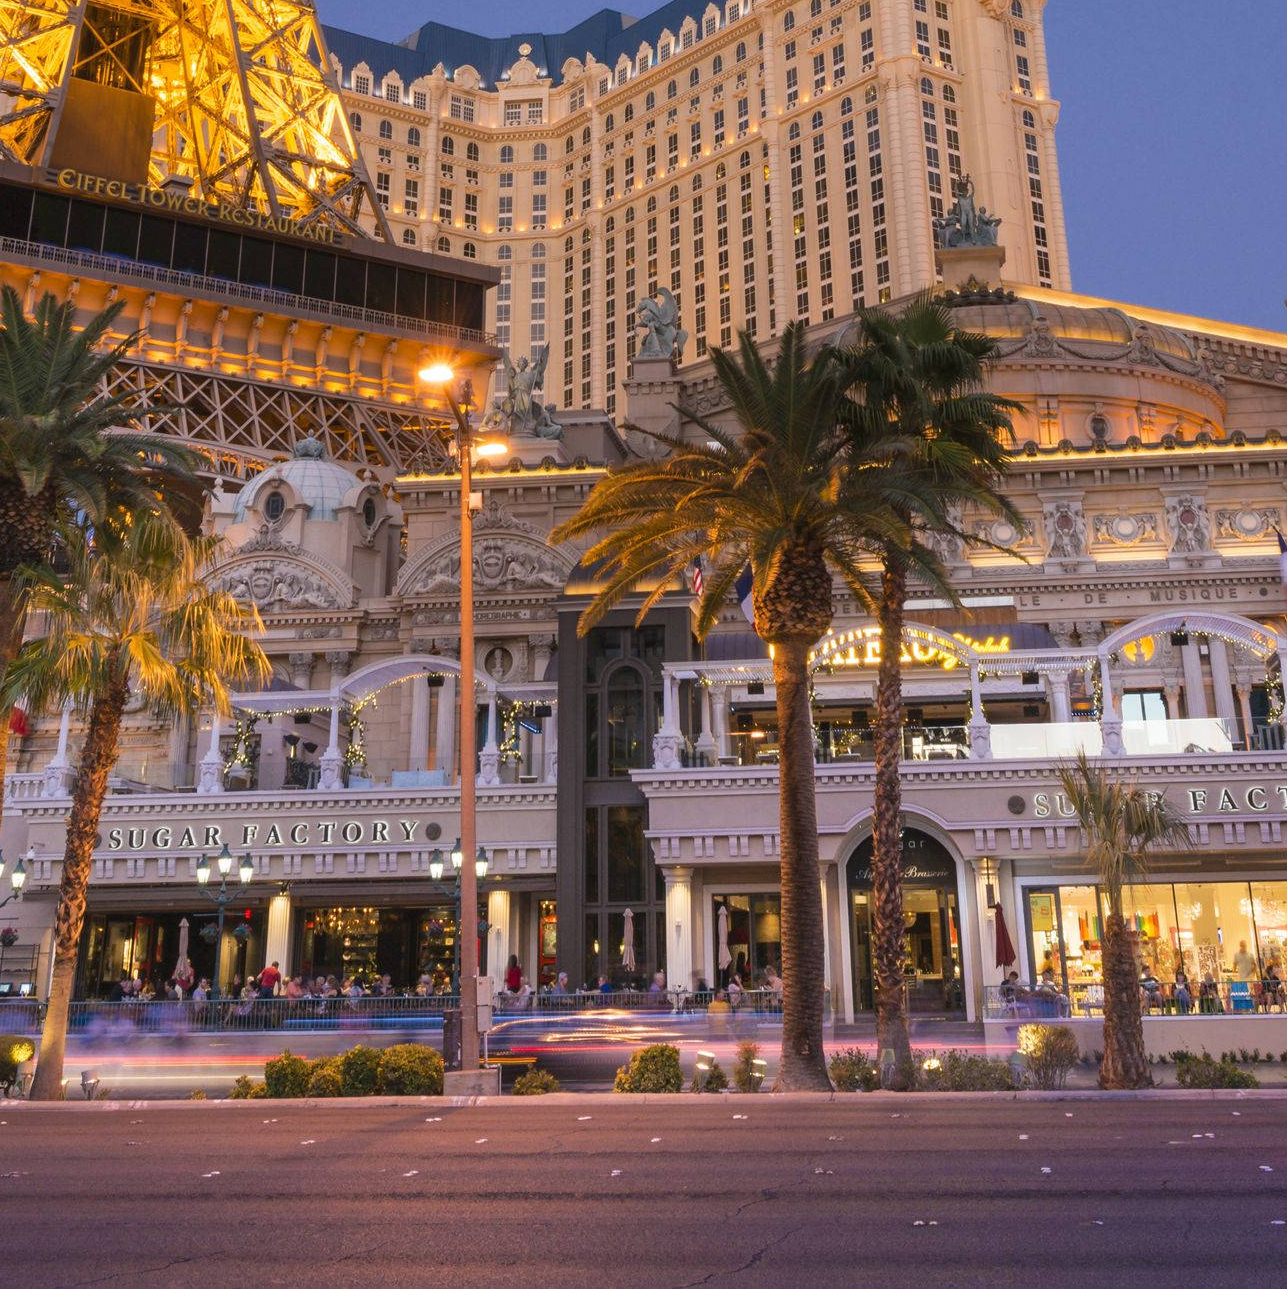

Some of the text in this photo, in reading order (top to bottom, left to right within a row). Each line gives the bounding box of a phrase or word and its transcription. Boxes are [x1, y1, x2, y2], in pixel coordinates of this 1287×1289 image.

[58, 168, 337, 244] EIFFEL TOWER RESTAURANT
[1083, 592, 1108, 605] DE
[1150, 587, 1239, 603] MUSIQUE
[107, 820, 419, 850] SUGAR FACTORY
